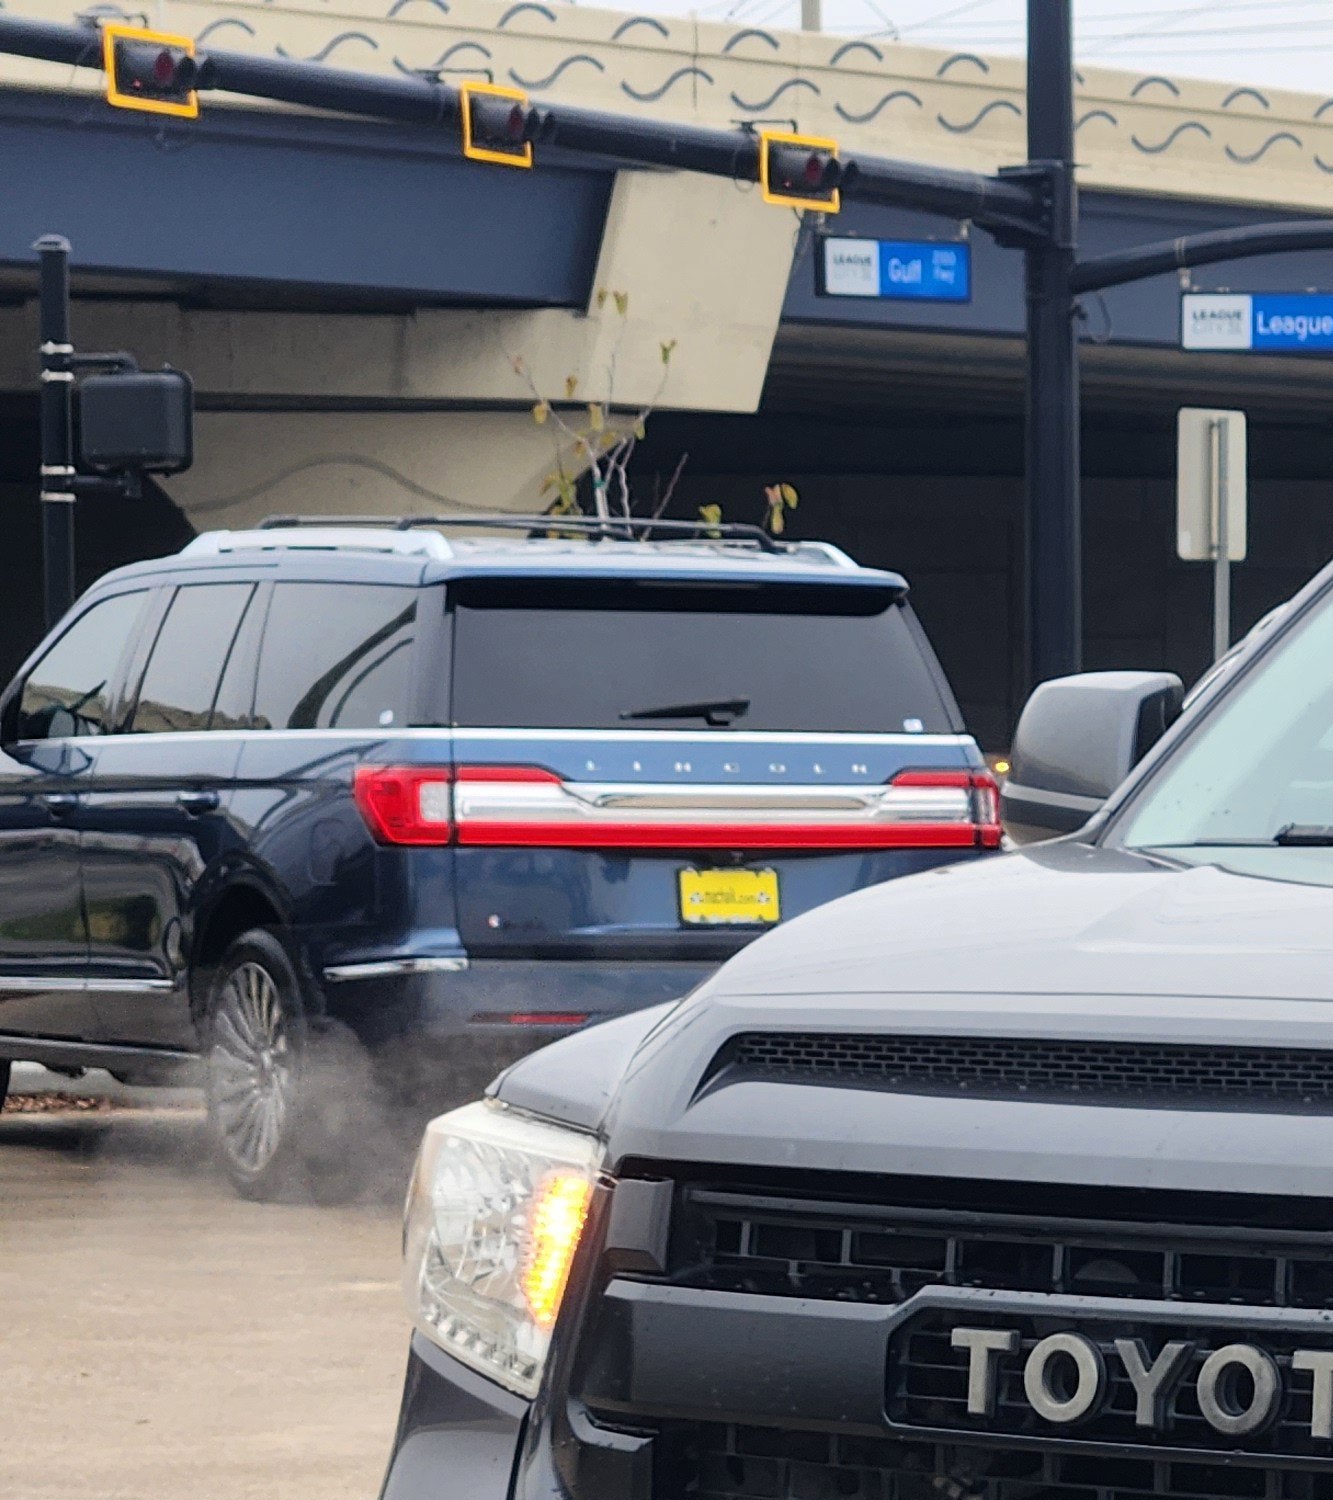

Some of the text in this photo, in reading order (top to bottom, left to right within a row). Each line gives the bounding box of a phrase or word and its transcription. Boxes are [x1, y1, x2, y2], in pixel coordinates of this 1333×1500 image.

[1192, 309, 1242, 321] LEAGUE
[1256, 311, 1333, 341] League
[585, 759, 868, 775] LINCOLN
